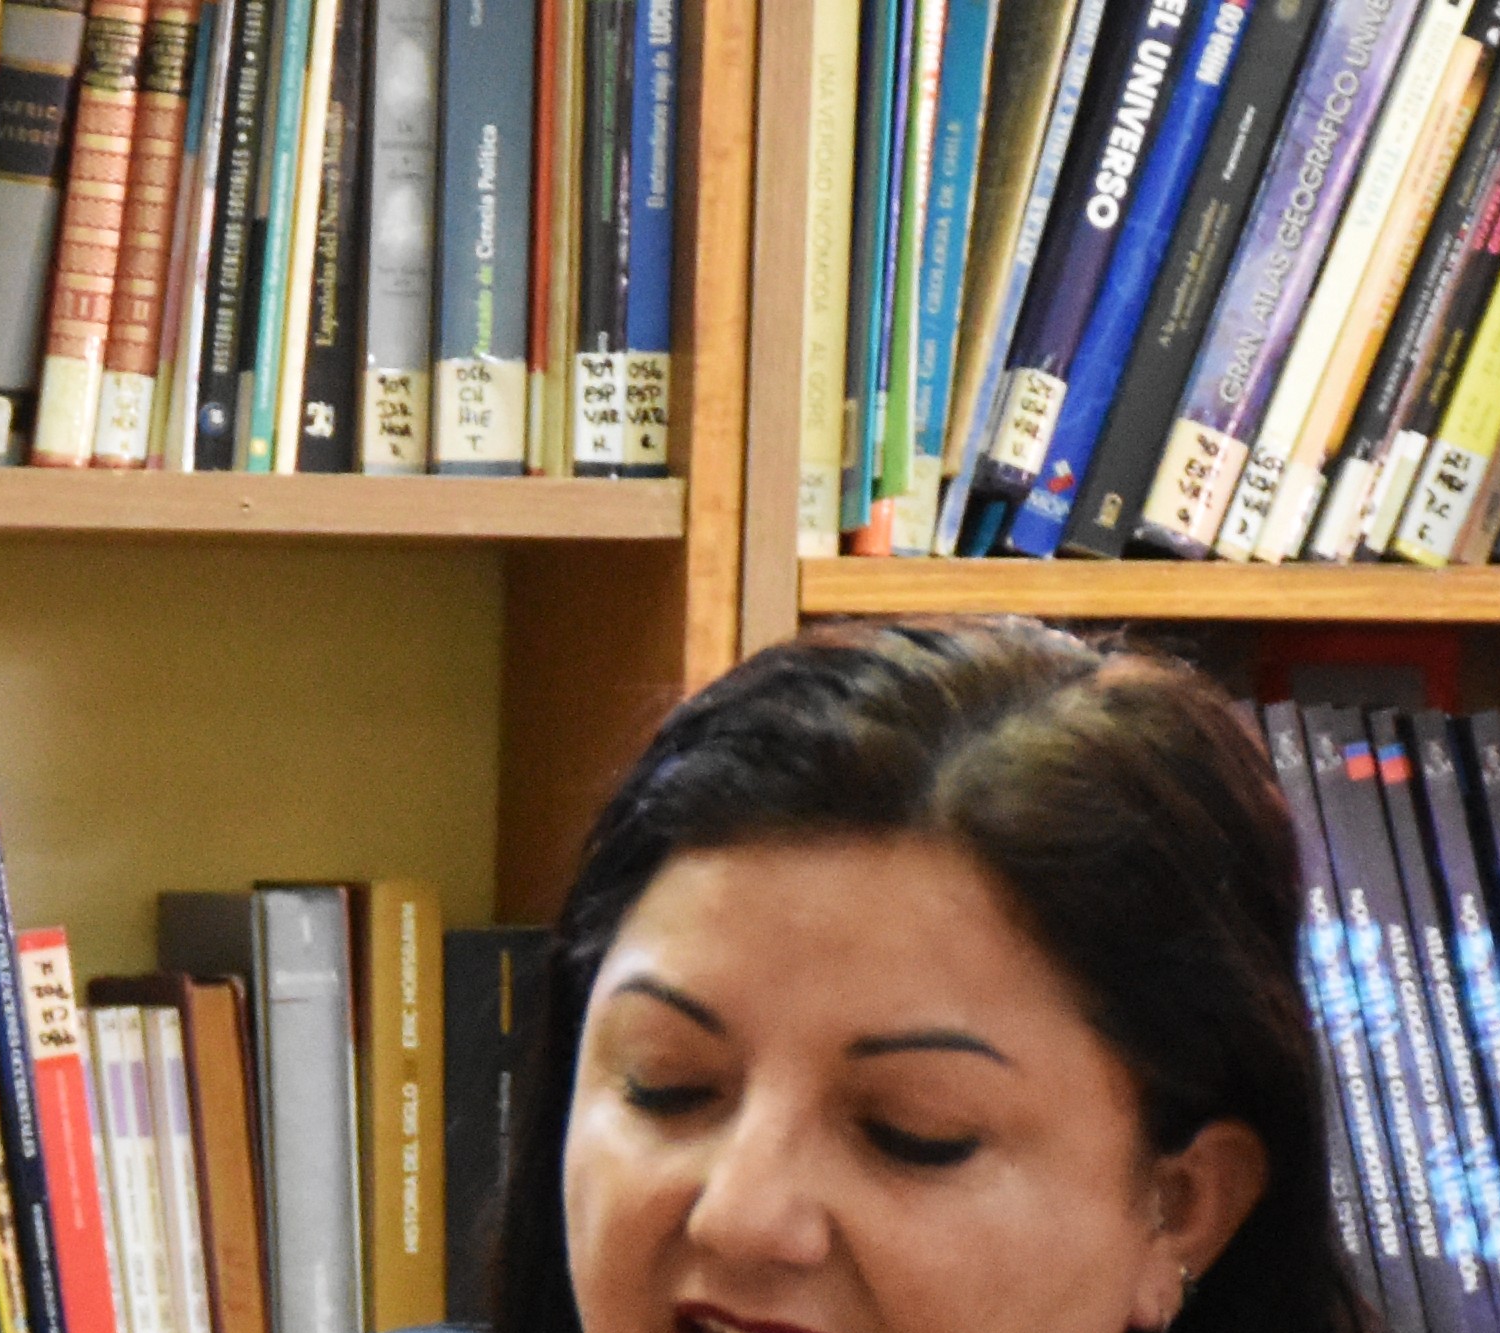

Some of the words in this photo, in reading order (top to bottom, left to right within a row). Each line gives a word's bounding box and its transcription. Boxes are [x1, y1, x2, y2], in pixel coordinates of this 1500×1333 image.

[1192, 30, 1236, 87] MIRA
[475, 123, 499, 189] Política
[1076, 36, 1178, 231] UNIVERSO
[225, 148, 250, 216] SOCIALES
[218, 221, 242, 289] CIENCIAS
[474, 194, 497, 257] Ciencia
[1213, 326, 1263, 405] GRAN
[1243, 246, 1294, 324] ATLAS
[1269, 66, 1363, 250] GEOGRAFICO
[403, 1009, 417, 1047] ERIC
[403, 1083, 417, 1135] SIGLO
[403, 1141, 417, 1171] DEL
[403, 1175, 417, 1252] HISTORIA
